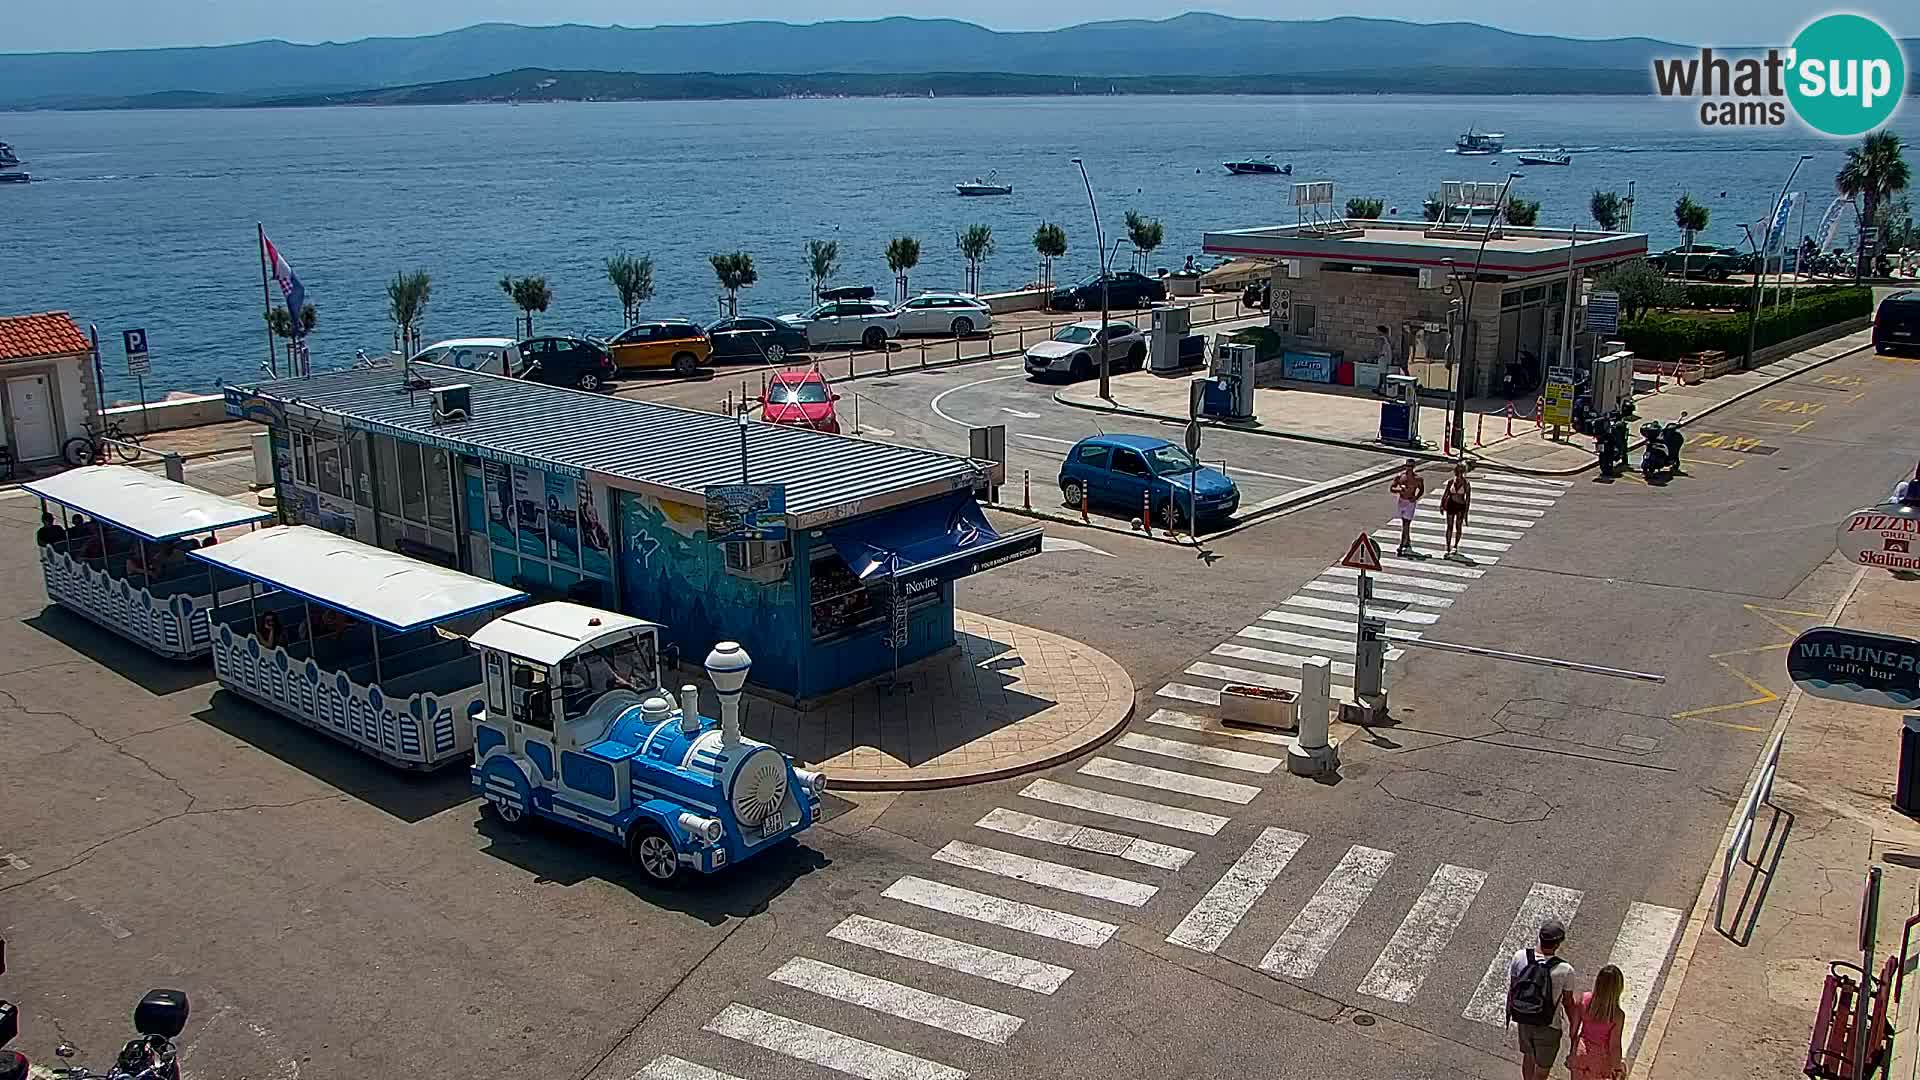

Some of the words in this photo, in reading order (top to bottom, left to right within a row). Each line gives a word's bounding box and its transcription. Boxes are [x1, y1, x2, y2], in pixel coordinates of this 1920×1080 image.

[127, 332, 141, 350] P
[1759, 399, 1828, 415] TAXI
[1685, 432, 1765, 452] TAXI
[477, 447, 492, 459] BUS
[493, 451, 525, 466] STATION
[527, 458, 552, 473] TICKET
[554, 463, 581, 478] OFFICE
[1881, 531, 1917, 541] GRILL
[905, 576, 939, 595] iNovine
[1870, 666, 1896, 681] bar
